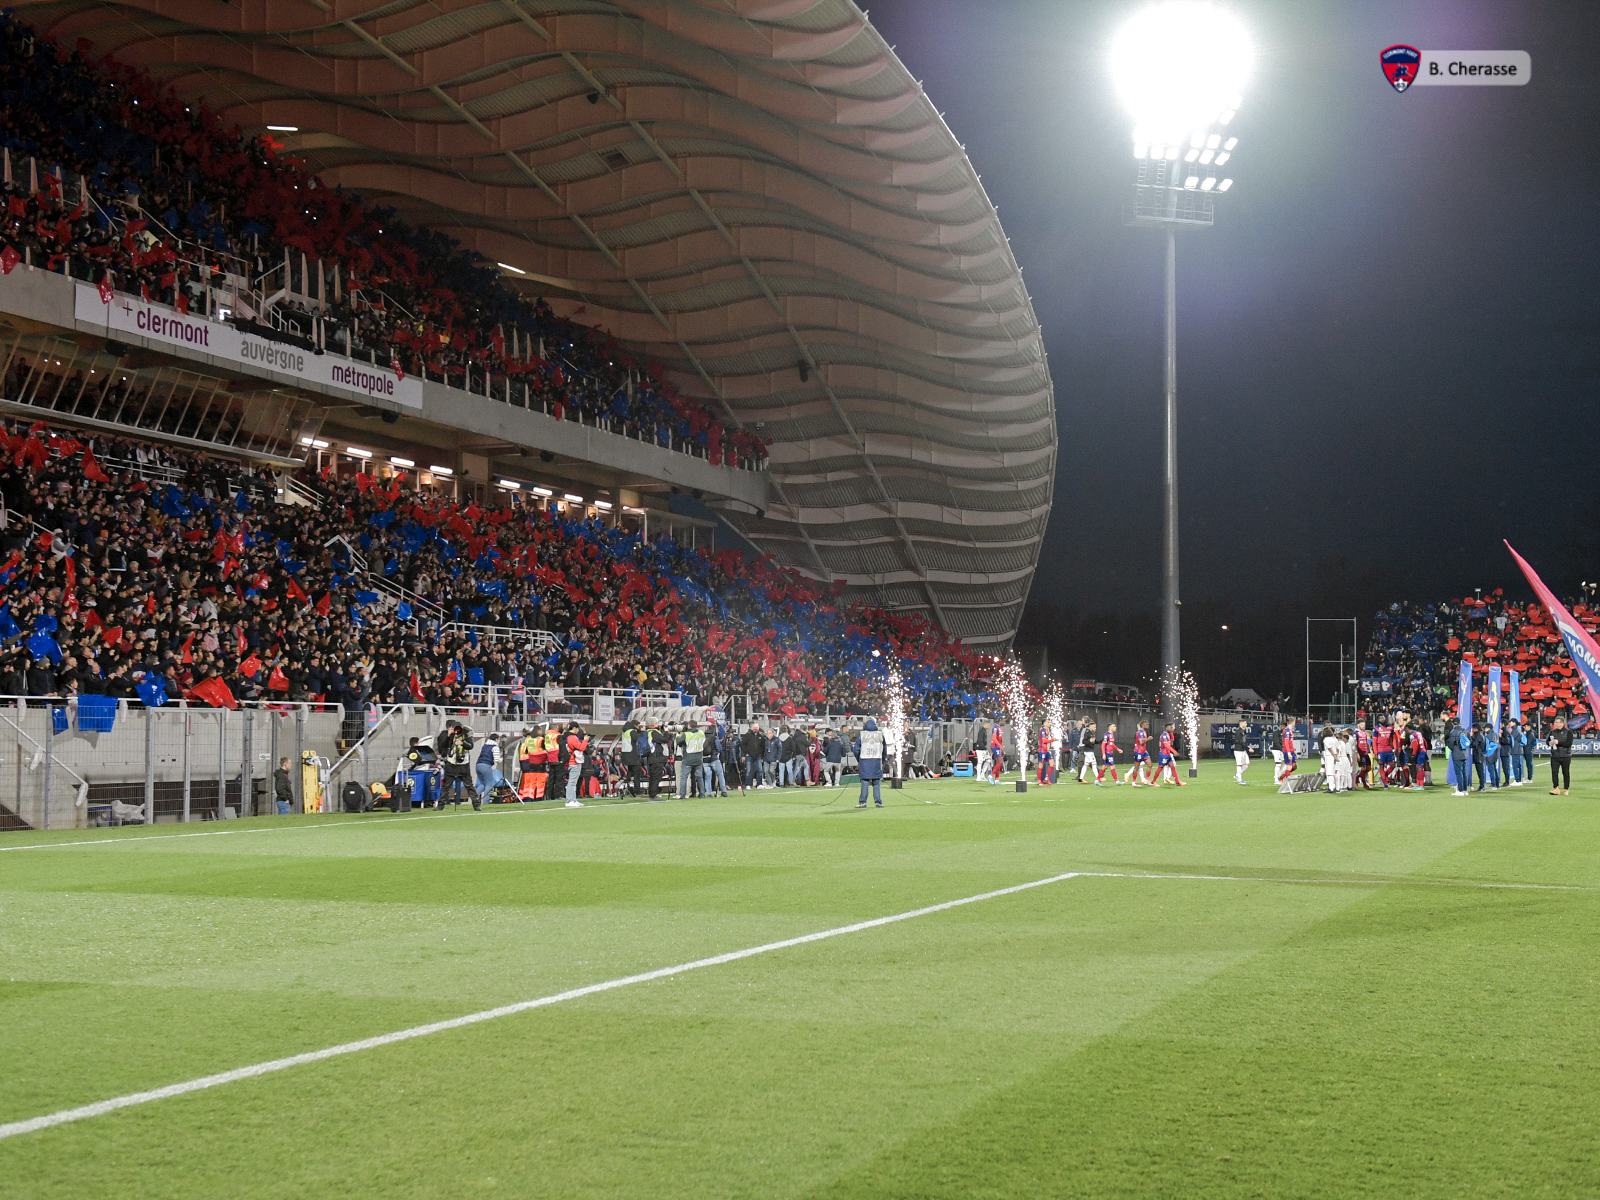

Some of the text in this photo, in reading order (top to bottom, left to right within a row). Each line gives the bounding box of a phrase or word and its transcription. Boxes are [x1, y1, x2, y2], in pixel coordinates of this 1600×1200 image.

[136, 308, 395, 396] clermont auvergne métropole
